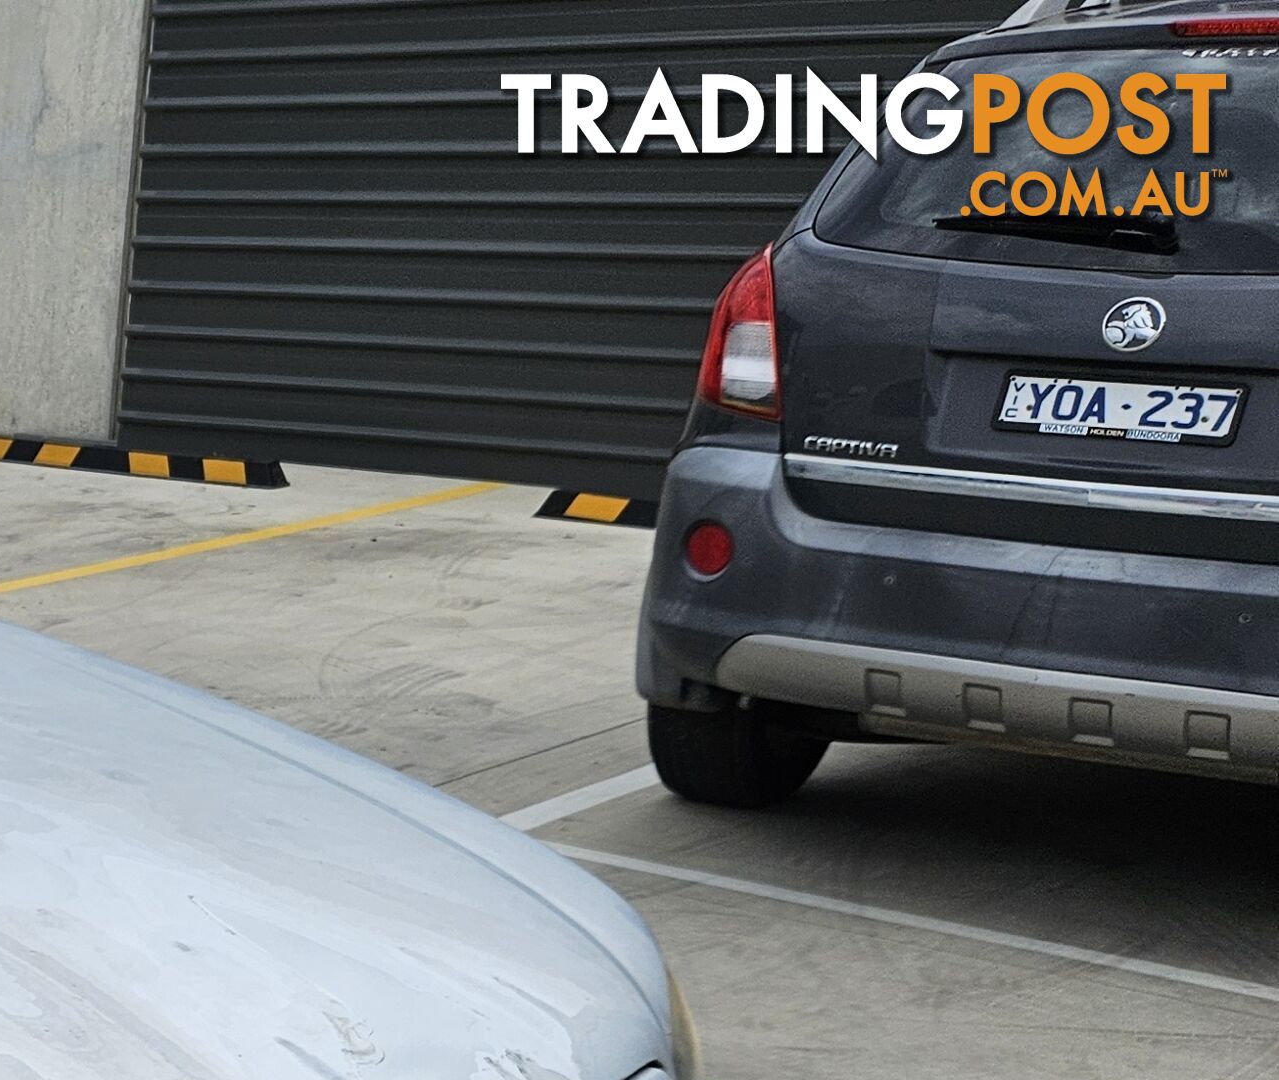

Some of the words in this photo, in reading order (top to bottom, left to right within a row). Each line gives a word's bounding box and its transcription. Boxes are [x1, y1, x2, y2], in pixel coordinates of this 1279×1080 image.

[1005, 382, 1026, 418] VIC
[1044, 424, 1084, 434] WATSON
[1089, 428, 1125, 437] HOLDEN
[804, 436, 899, 458] CAPTIVA
